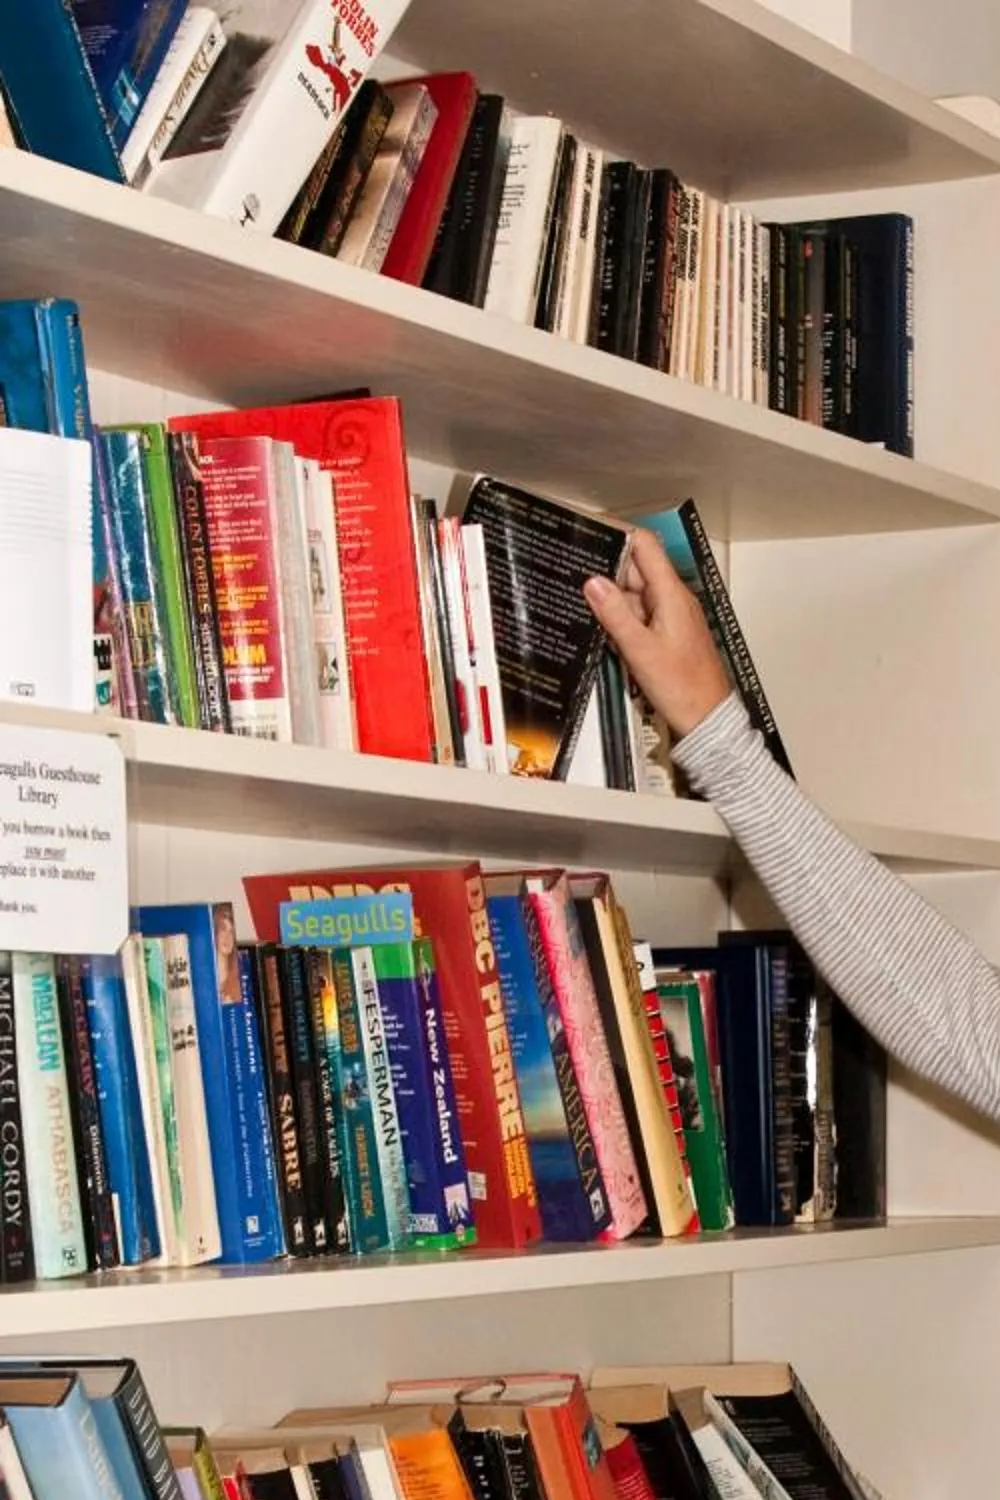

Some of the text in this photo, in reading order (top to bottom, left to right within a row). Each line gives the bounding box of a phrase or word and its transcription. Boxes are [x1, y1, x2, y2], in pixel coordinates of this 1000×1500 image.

[331, 0, 375, 57] FORBES
[184, 485, 202, 544] COLIN
[191, 547, 212, 616] FORBES
[0, 759, 102, 786] eagulls Guesthouse
[18, 785, 58, 810] Library
[2, 820, 21, 837] you
[23, 818, 56, 836] borrow
[66, 823, 90, 840] book
[90, 826, 112, 843] then
[0, 862, 28, 879] eplace
[39, 864, 60, 880] with
[62, 866, 97, 882] another
[287, 903, 406, 944] Seagulls
[464, 877, 524, 1139] DBC PIERRE
[0, 978, 25, 1226] MICHAEL CORDY
[364, 988, 398, 1147] FESPERMAN
[423, 1008, 457, 1164] New Zealand
[278, 1094, 302, 1193] SABRE
[554, 1051, 597, 1195] AMERICA
[44, 1084, 75, 1235] ATHABASCA
[88, 1125, 106, 1196] Dilemma
[360, 1181, 376, 1218] LOCK
[129, 1388, 166, 1460] DAVID
